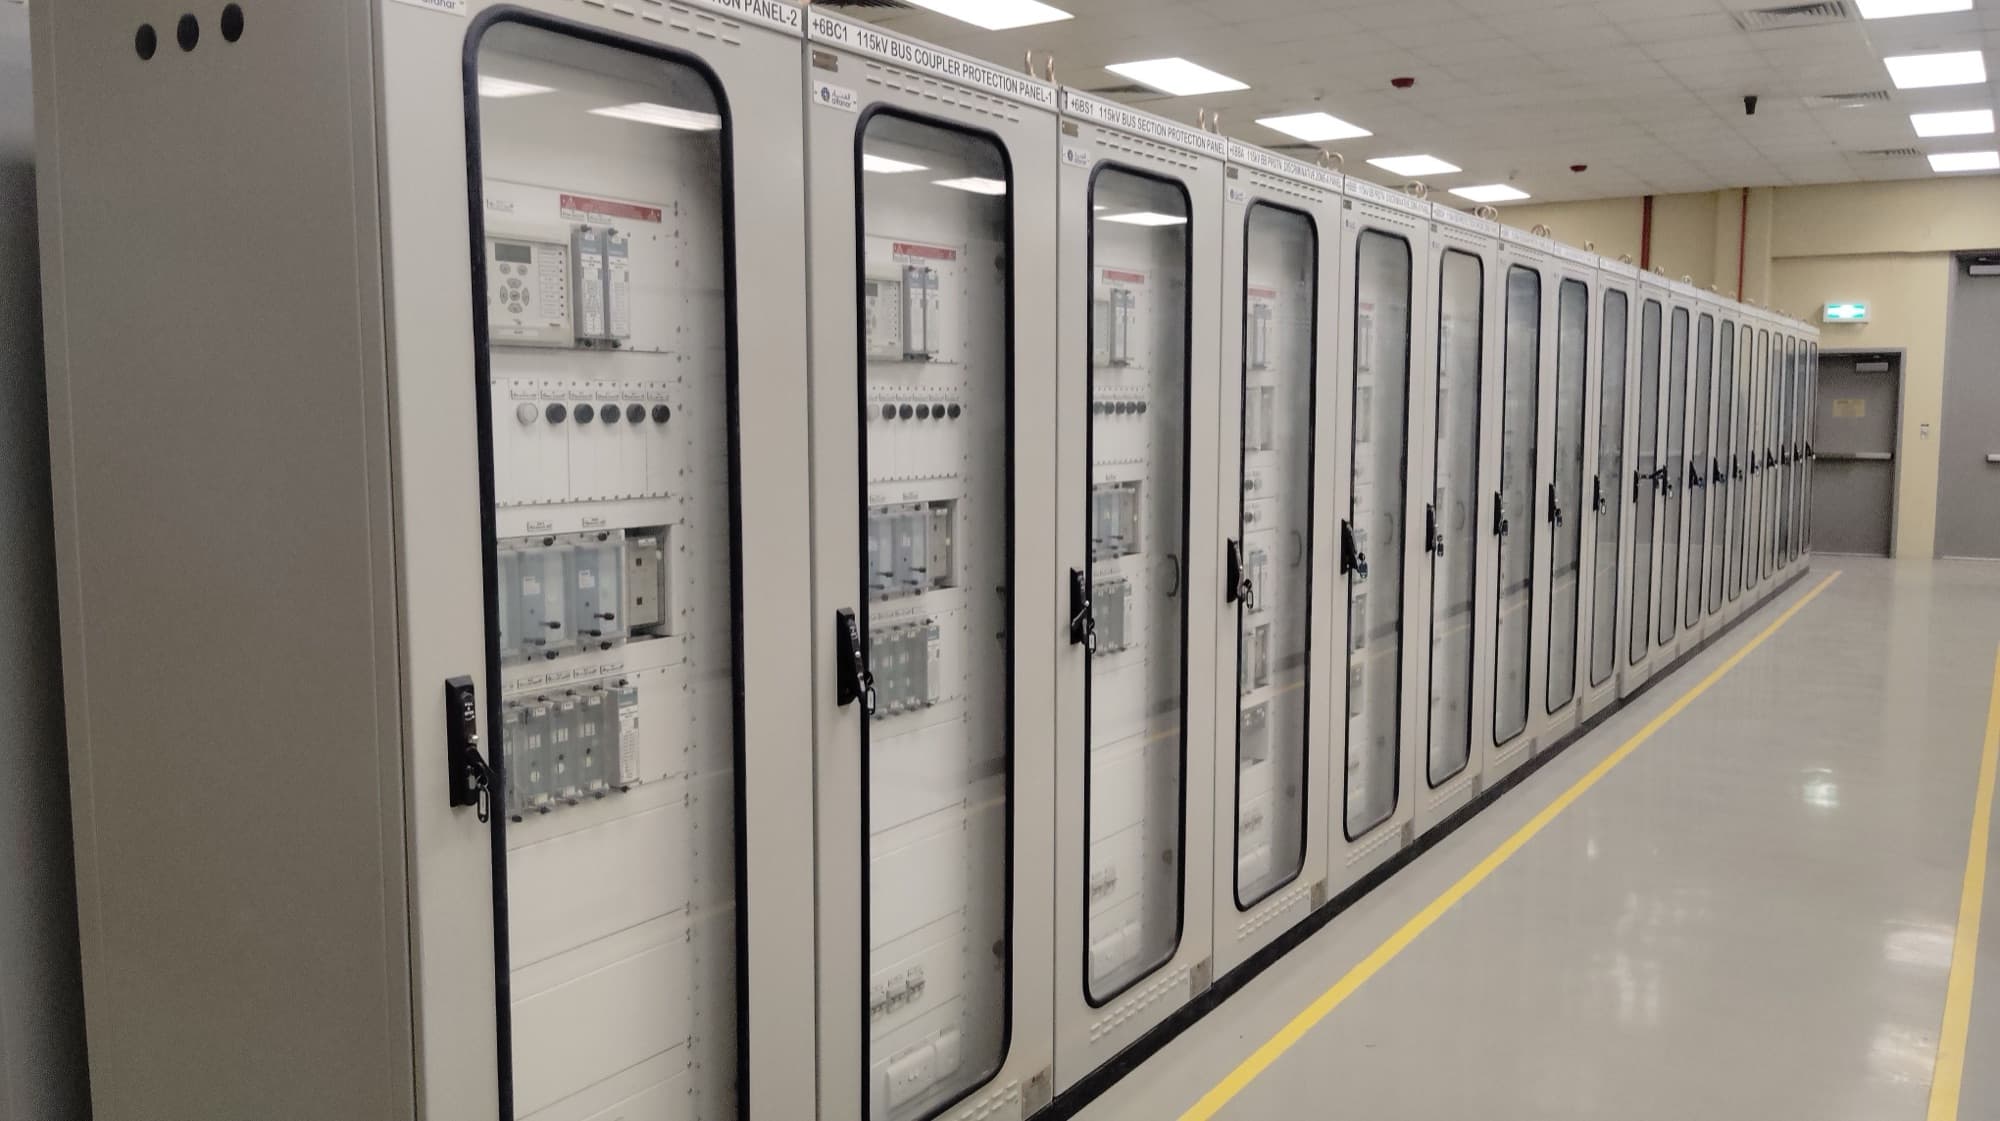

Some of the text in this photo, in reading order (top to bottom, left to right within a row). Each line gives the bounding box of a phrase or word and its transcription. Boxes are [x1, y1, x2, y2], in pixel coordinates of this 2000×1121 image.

[813, 18, 1052, 105] +6BC1 115kV BUS COUPLER PROTECTION PANEL-1
[1071, 97, 1226, 156] +6BS1 115kV BUS SECTION PROTECTION PANEL
